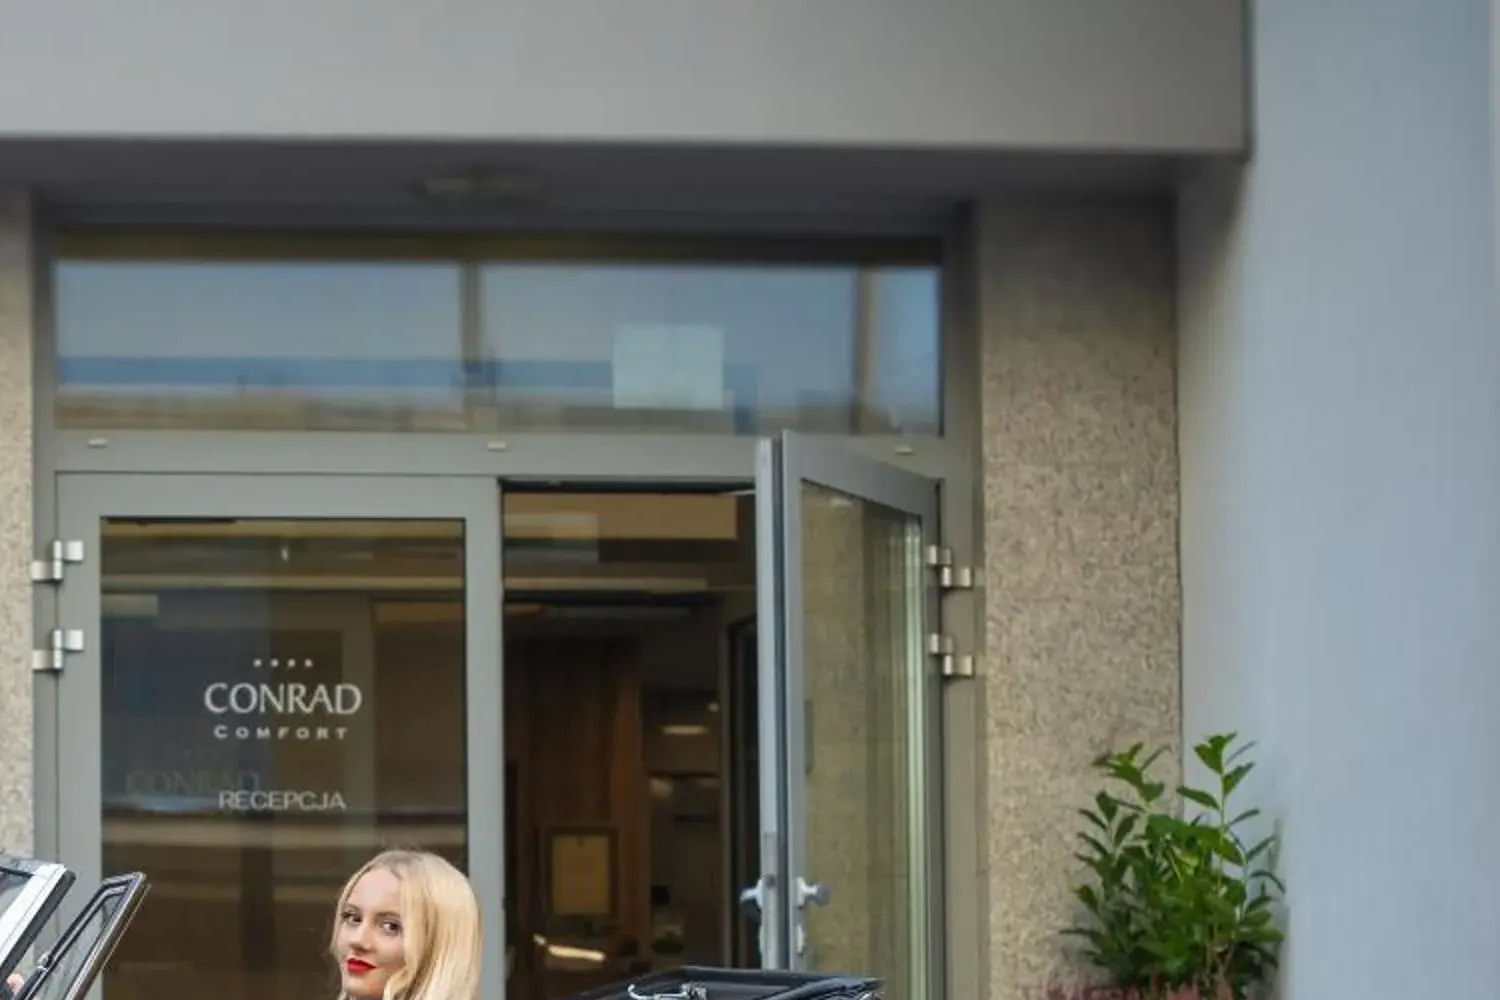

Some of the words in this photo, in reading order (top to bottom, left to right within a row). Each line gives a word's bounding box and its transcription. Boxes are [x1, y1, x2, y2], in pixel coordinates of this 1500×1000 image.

[203, 682, 363, 715] CONRAD
[213, 725, 348, 740] COMFORT
[218, 790, 347, 811] RECEPCJA
